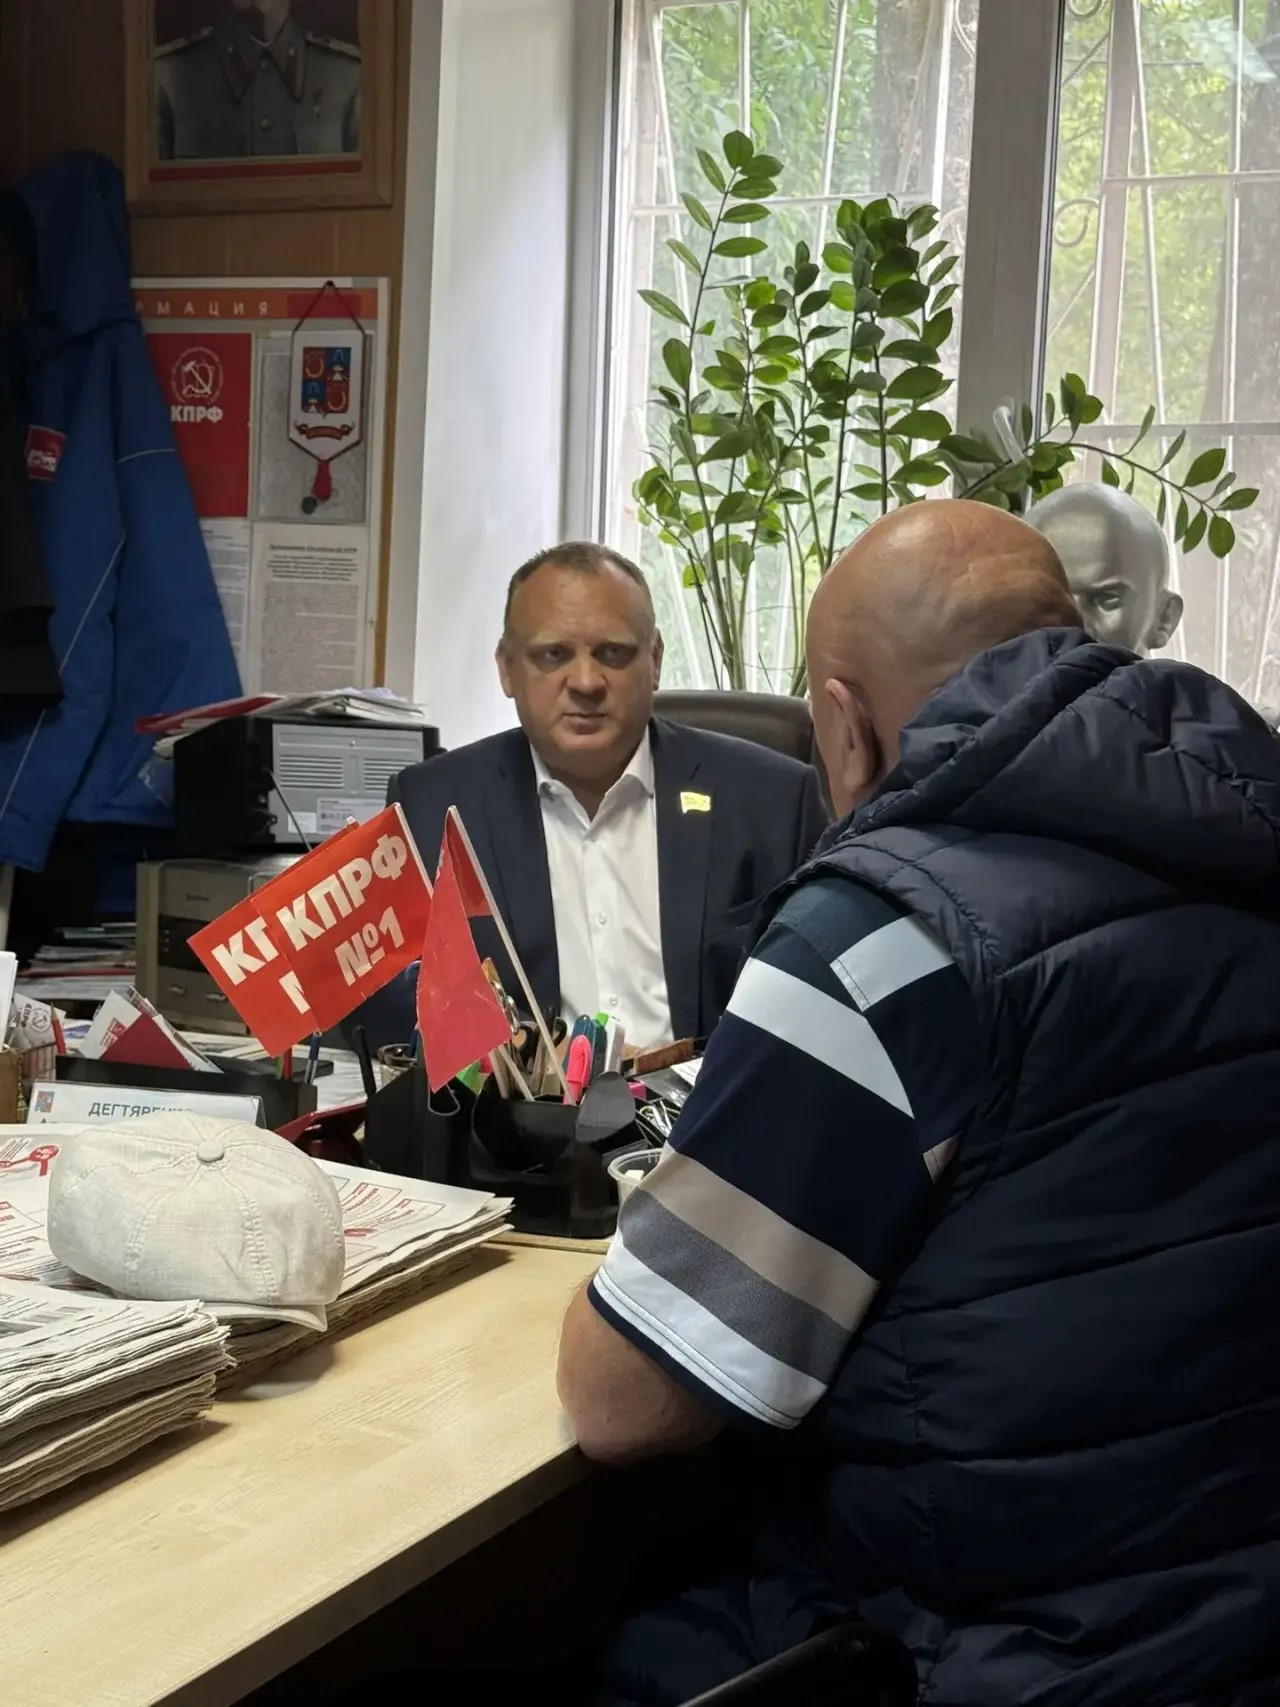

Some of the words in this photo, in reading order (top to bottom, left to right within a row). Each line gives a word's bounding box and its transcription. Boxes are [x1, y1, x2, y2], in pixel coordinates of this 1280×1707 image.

[170, 405, 224, 423] КПРФ
[276, 834, 408, 952] КПРФ
[334, 906, 405, 988] №1
[88, 1102, 193, 1117] ДЕГТЯР
